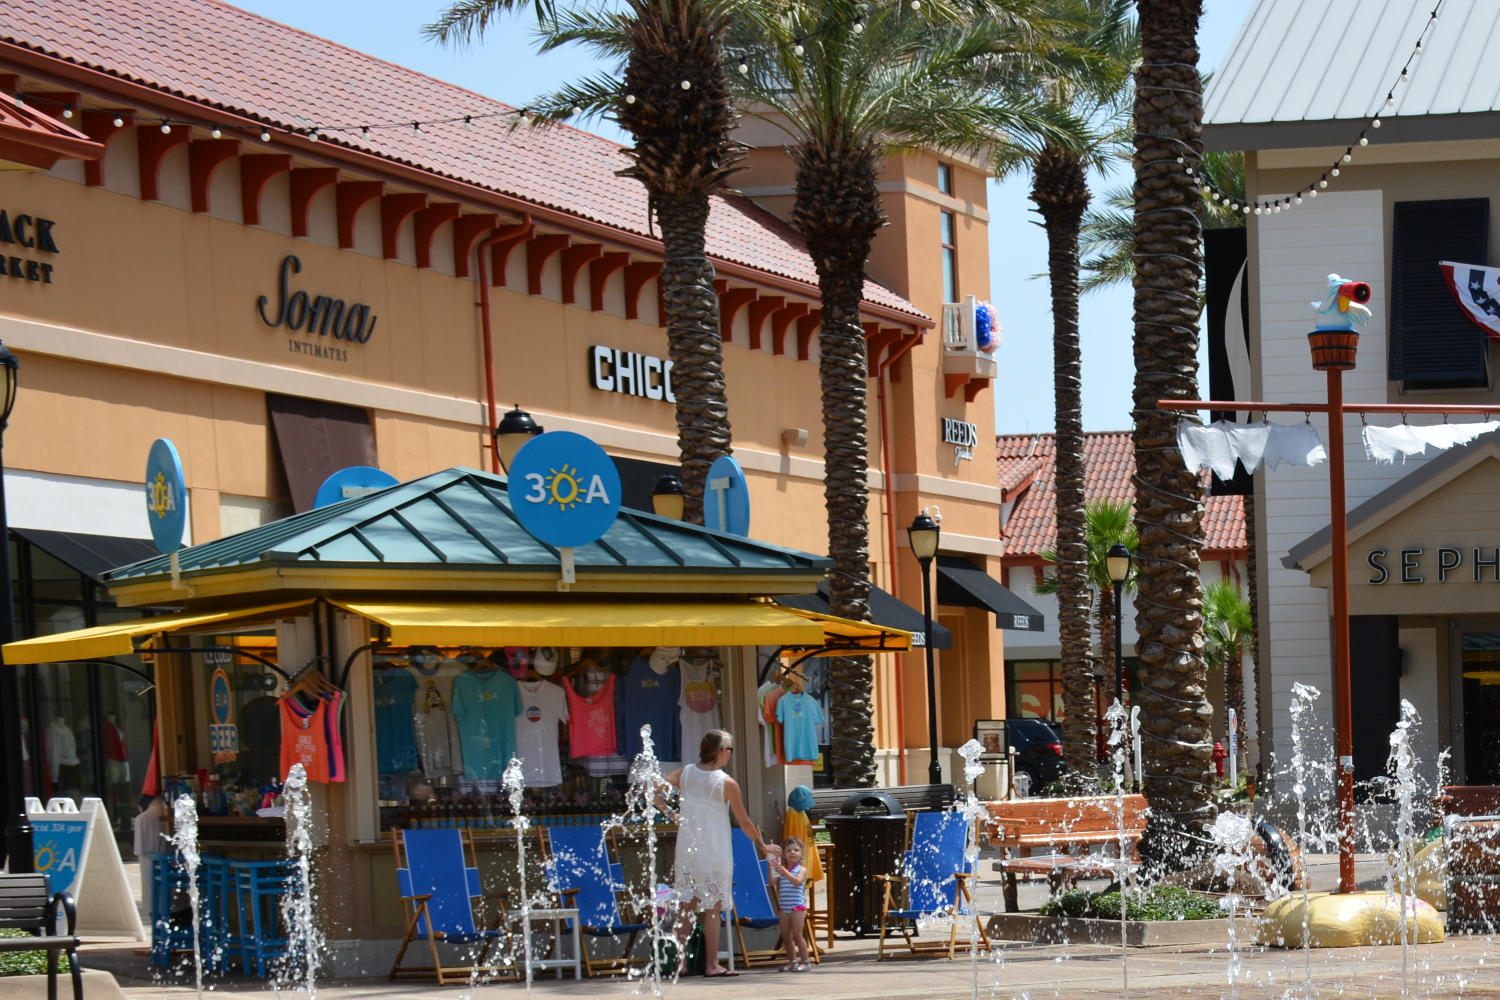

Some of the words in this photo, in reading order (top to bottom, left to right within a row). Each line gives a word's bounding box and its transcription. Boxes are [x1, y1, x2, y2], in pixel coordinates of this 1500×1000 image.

[257, 254, 377, 344] Soma
[289, 340, 348, 362] INTIMATES
[942, 417, 978, 448] REEDS
[1021, 693, 1065, 722] SA
[210, 724, 240, 753] BEER
